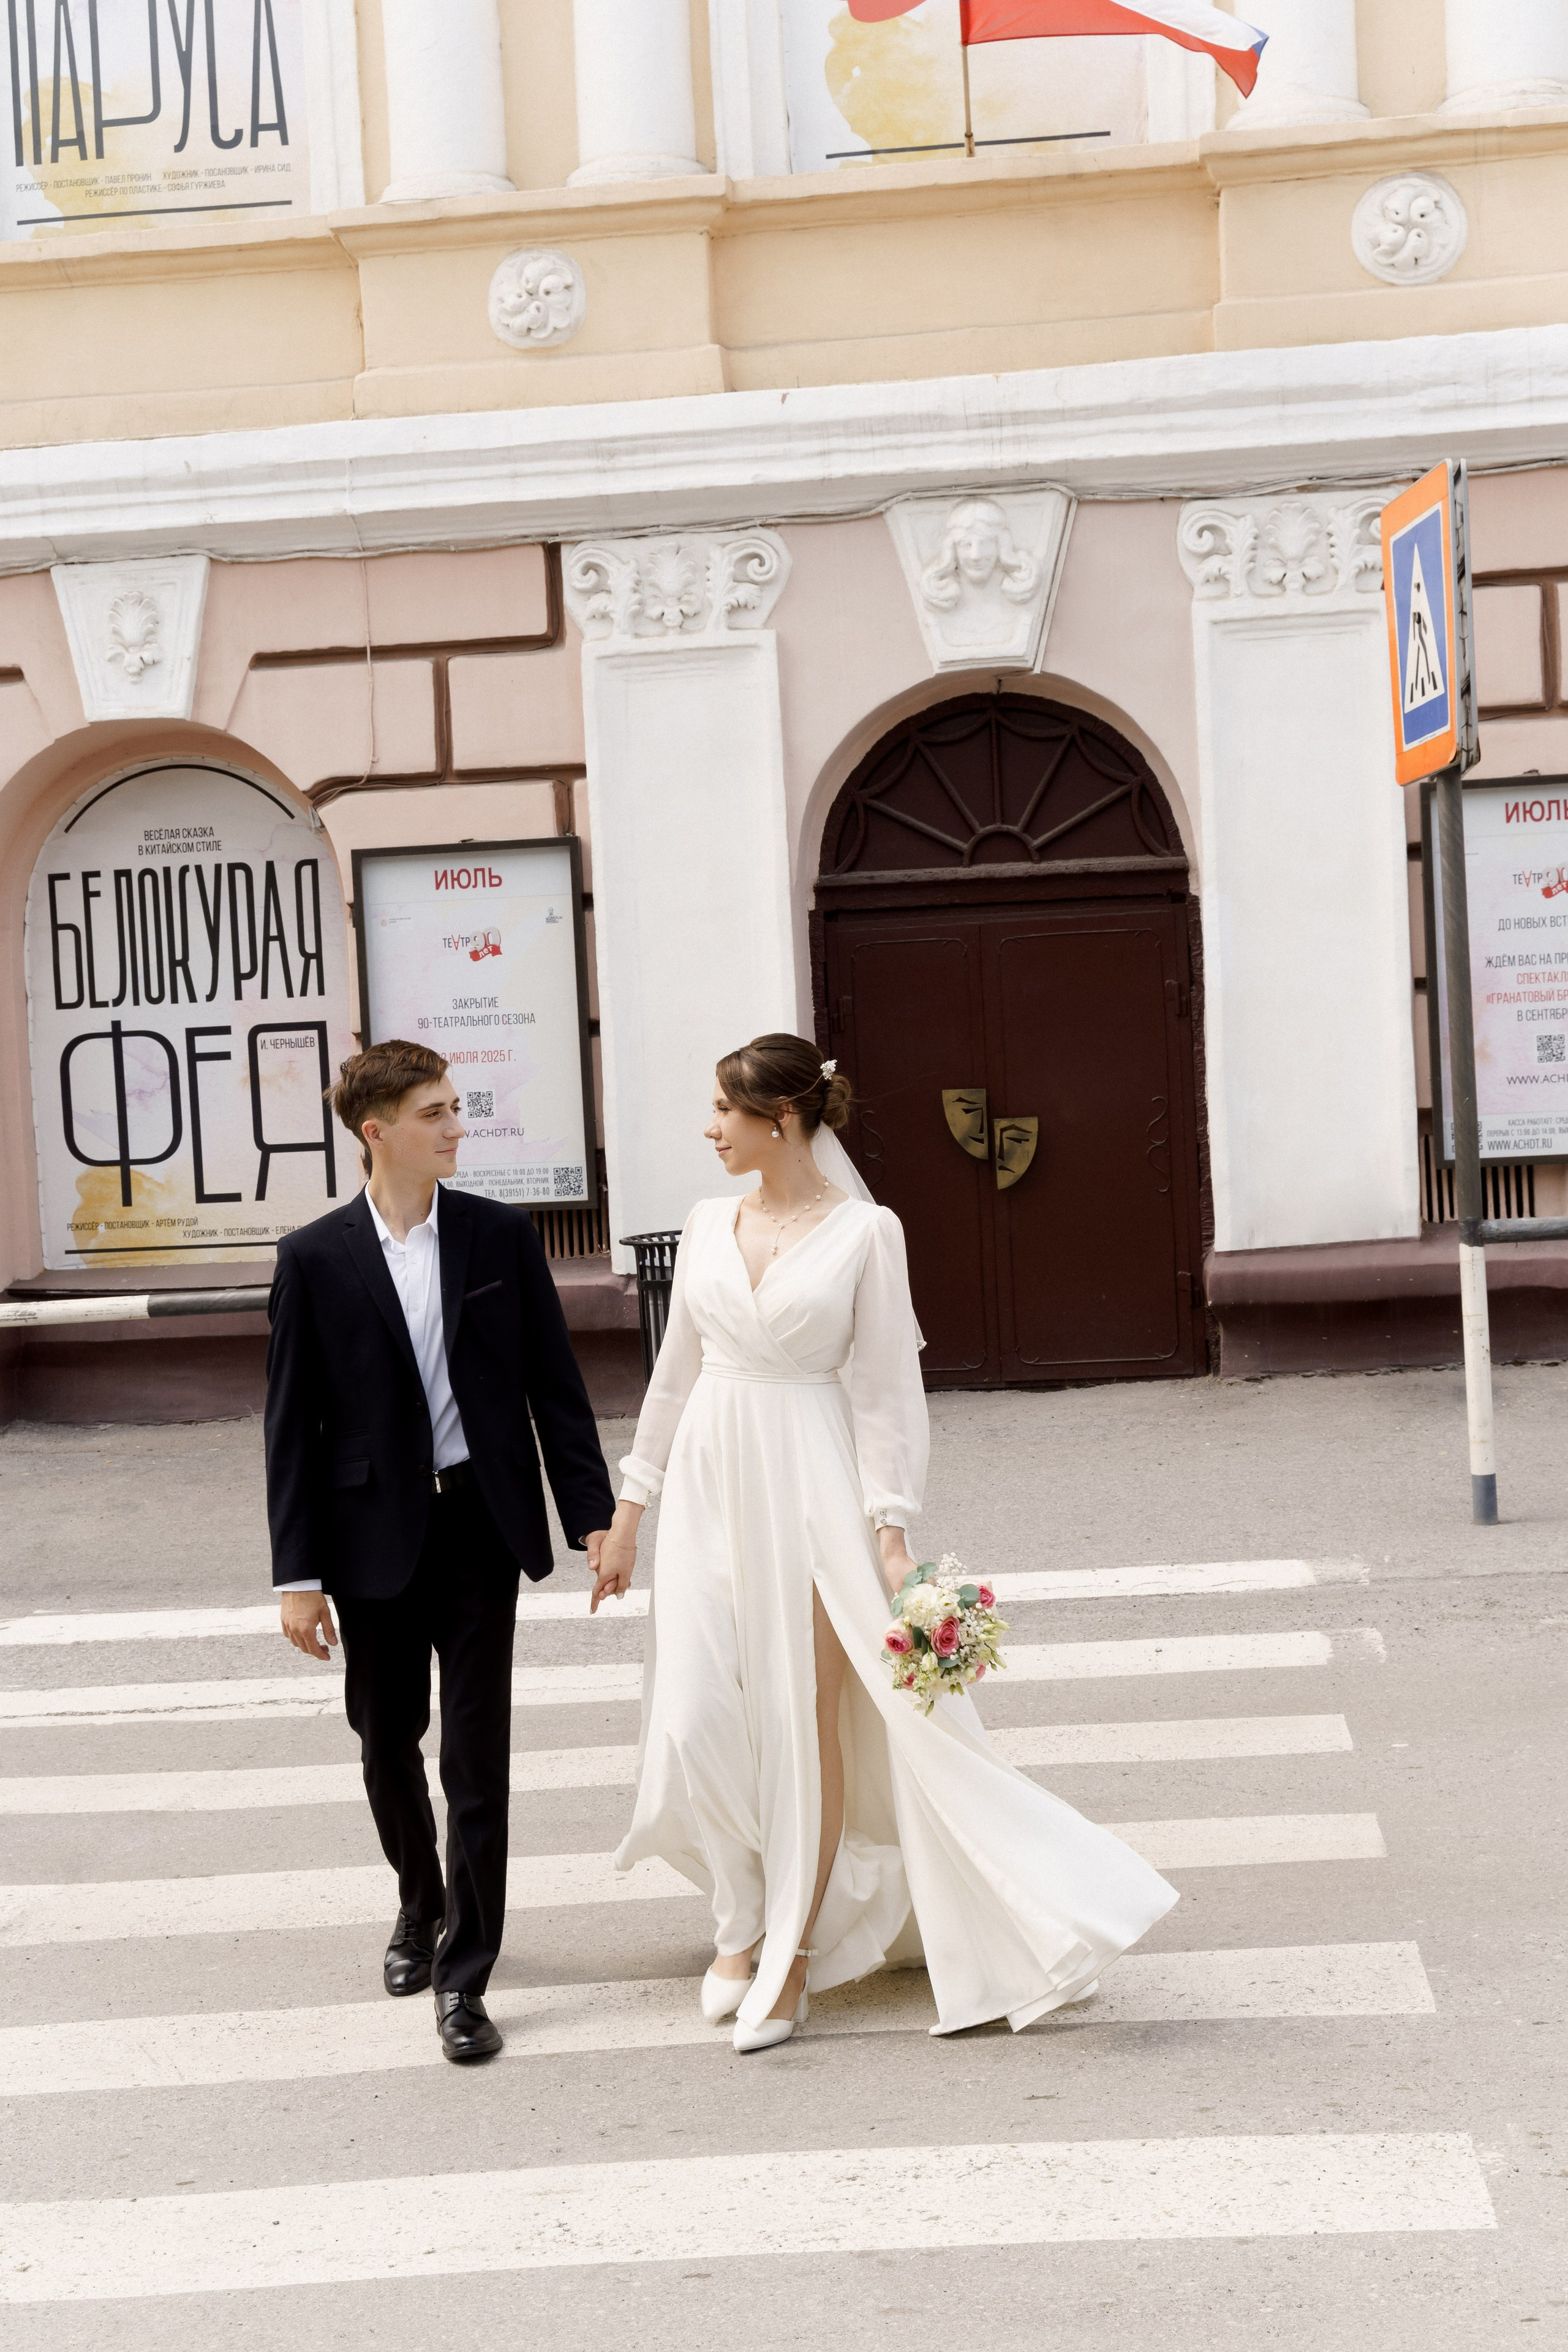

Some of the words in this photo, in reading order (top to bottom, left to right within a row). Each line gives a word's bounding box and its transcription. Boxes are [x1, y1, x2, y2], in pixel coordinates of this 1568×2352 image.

[163, 170, 199, 180] ХУДОЖНИК
[255, 164, 276, 173] ИРИНА
[277, 163, 291, 172] СИД
[16, 181, 48, 192] РЕЖИССЁР
[53, 177, 99, 189] ПОСТАНОВЩИК
[105, 175, 126, 184] ПАВЕЛ
[127, 173, 152, 183] ПРОНИН
[85, 187, 118, 198] РЕЖИССЁР
[129, 184, 162, 194] ПЛАСТИКЕ
[167, 182, 190, 192] СОФЬЯ
[190, 180, 225, 190] ГУРЖИЕВА
[144, 827, 180, 841] ВЕСЁЛАЯ
[183, 827, 214, 839] СКАЗКА
[138, 845, 143, 856] В
[145, 842, 194, 855] КИТАЙСКОМ
[196, 840, 222, 852] СТИЛЕ
[434, 867, 502, 890] ИЮЛЬ
[1498, 918, 1511, 932] ДО
[1513, 916, 1547, 929] НОВЫХ
[1550, 915, 1568, 927] ВСТ
[47, 858, 325, 1010] БЕЛОКУРАЯ
[470, 926, 501, 951] 90
[479, 946, 492, 958] лет
[1485, 954, 1516, 968] ЖДЁМ
[1518, 954, 1537, 966] ВАС
[1539, 953, 1552, 965] НА
[1555, 952, 1568, 964] ПР
[1517, 971, 1568, 984] СПЕКТАКЛ
[452, 997, 499, 1009] ЗАКРЫТИЕ
[418, 1014, 499, 1028] 90-ТЕАТРАЛЬНОГО
[502, 1013, 535, 1025] СЕЗОНА
[1517, 1010, 1523, 1022] В
[1526, 1008, 1568, 1021] СЕНТЯБР
[260, 1039, 268, 1050] И.
[270, 1036, 315, 1049] ЧЕРНЫШЁВ
[450, 1051, 478, 1064] ИЮЛЯ
[481, 1050, 505, 1063] 2025
[508, 1049, 516, 1061] Г.
[1506, 1074, 1568, 1085] WWW.ACH
[59, 1019, 337, 1207] ФЕЯ
[1487, 1138, 1553, 1150] WWW.ACHDT.RU
[456, 1178, 484, 1188] ВЫХОДНОЙ
[484, 1189, 497, 1198] ТЕЛ.
[499, 1188, 524, 1199] 8(39151)
[526, 1186, 550, 1196] 7-36-80
[67, 1222, 98, 1231] РЕЖИССЁР
[105, 1219, 150, 1229] ПОСТАНОВЩИК
[156, 1218, 176, 1227] АРТЁМ
[178, 1216, 198, 1227] РУДОЙ
[183, 1228, 218, 1238] ХУДОЖНИК
[224, 1227, 270, 1236] ПОСТАНОВЩИК
